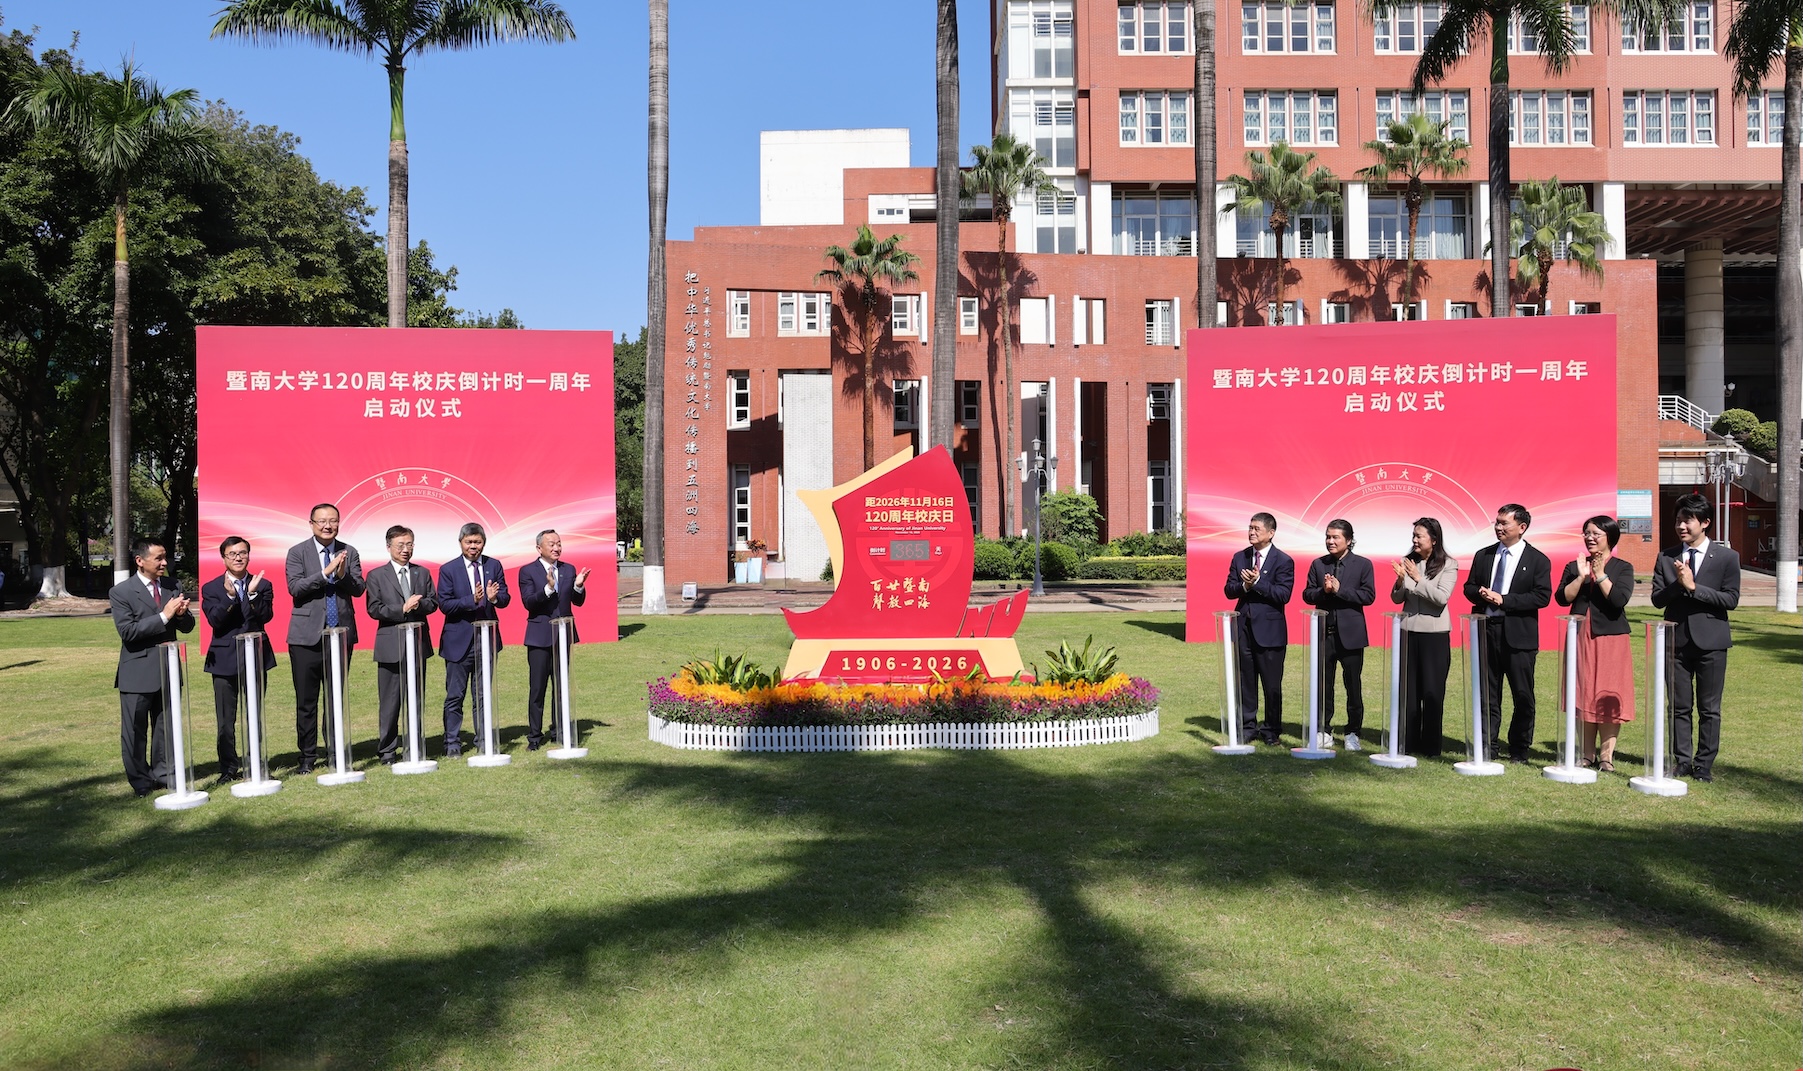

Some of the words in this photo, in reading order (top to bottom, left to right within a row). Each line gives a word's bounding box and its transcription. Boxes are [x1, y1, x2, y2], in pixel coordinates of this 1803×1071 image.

[226, 371, 592, 392] 暨南大学120周年校庆倒计时一周年
[1212, 360, 1589, 389] 暨南大学120周年校庆倒计时一周年
[363, 399, 462, 418] 启动仪式
[684, 269, 700, 535] 把中华优秀传统文化传播到五洲四海
[1344, 391, 1446, 413] 启动仪式
[382, 490, 402, 501] JINAN
[405, 489, 447, 500] UNIVERSITY
[1361, 485, 1382, 496] JINAN
[1385, 484, 1429, 496] UNIVERSITY
[865, 497, 954, 507] 距2026年11月16日
[865, 510, 954, 523] 120周年校庆日
[895, 543, 925, 558] 365
[842, 657, 967, 671] 1906-2026
